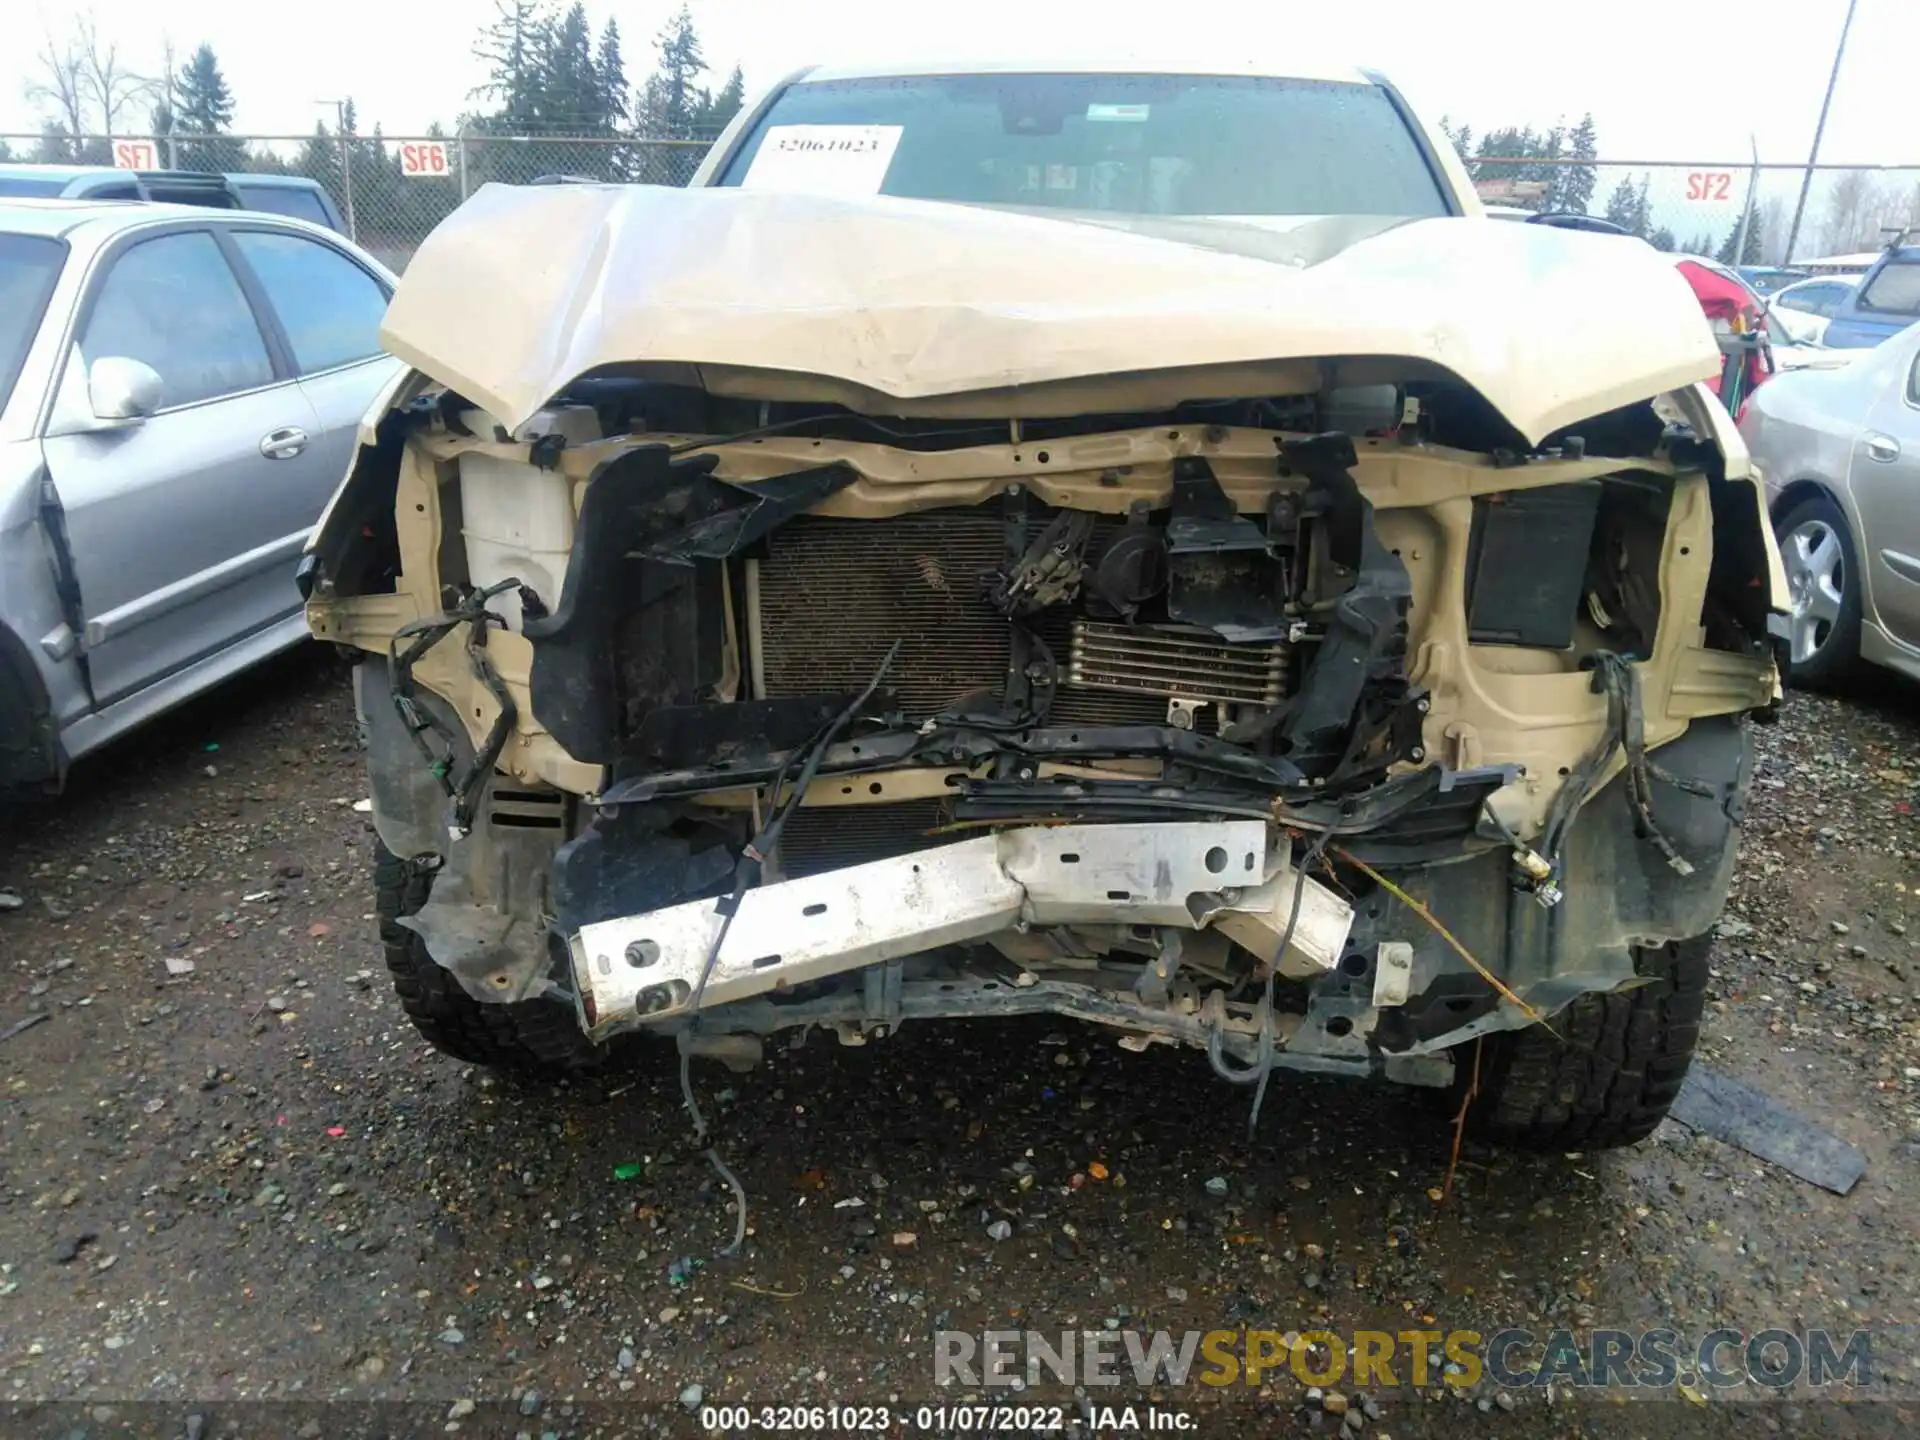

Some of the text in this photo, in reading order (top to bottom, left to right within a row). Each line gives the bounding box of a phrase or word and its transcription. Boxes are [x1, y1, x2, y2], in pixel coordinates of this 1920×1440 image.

[116, 144, 152, 169] SF7
[403, 145, 444, 172] SF6
[1686, 172, 1731, 201] SF2
